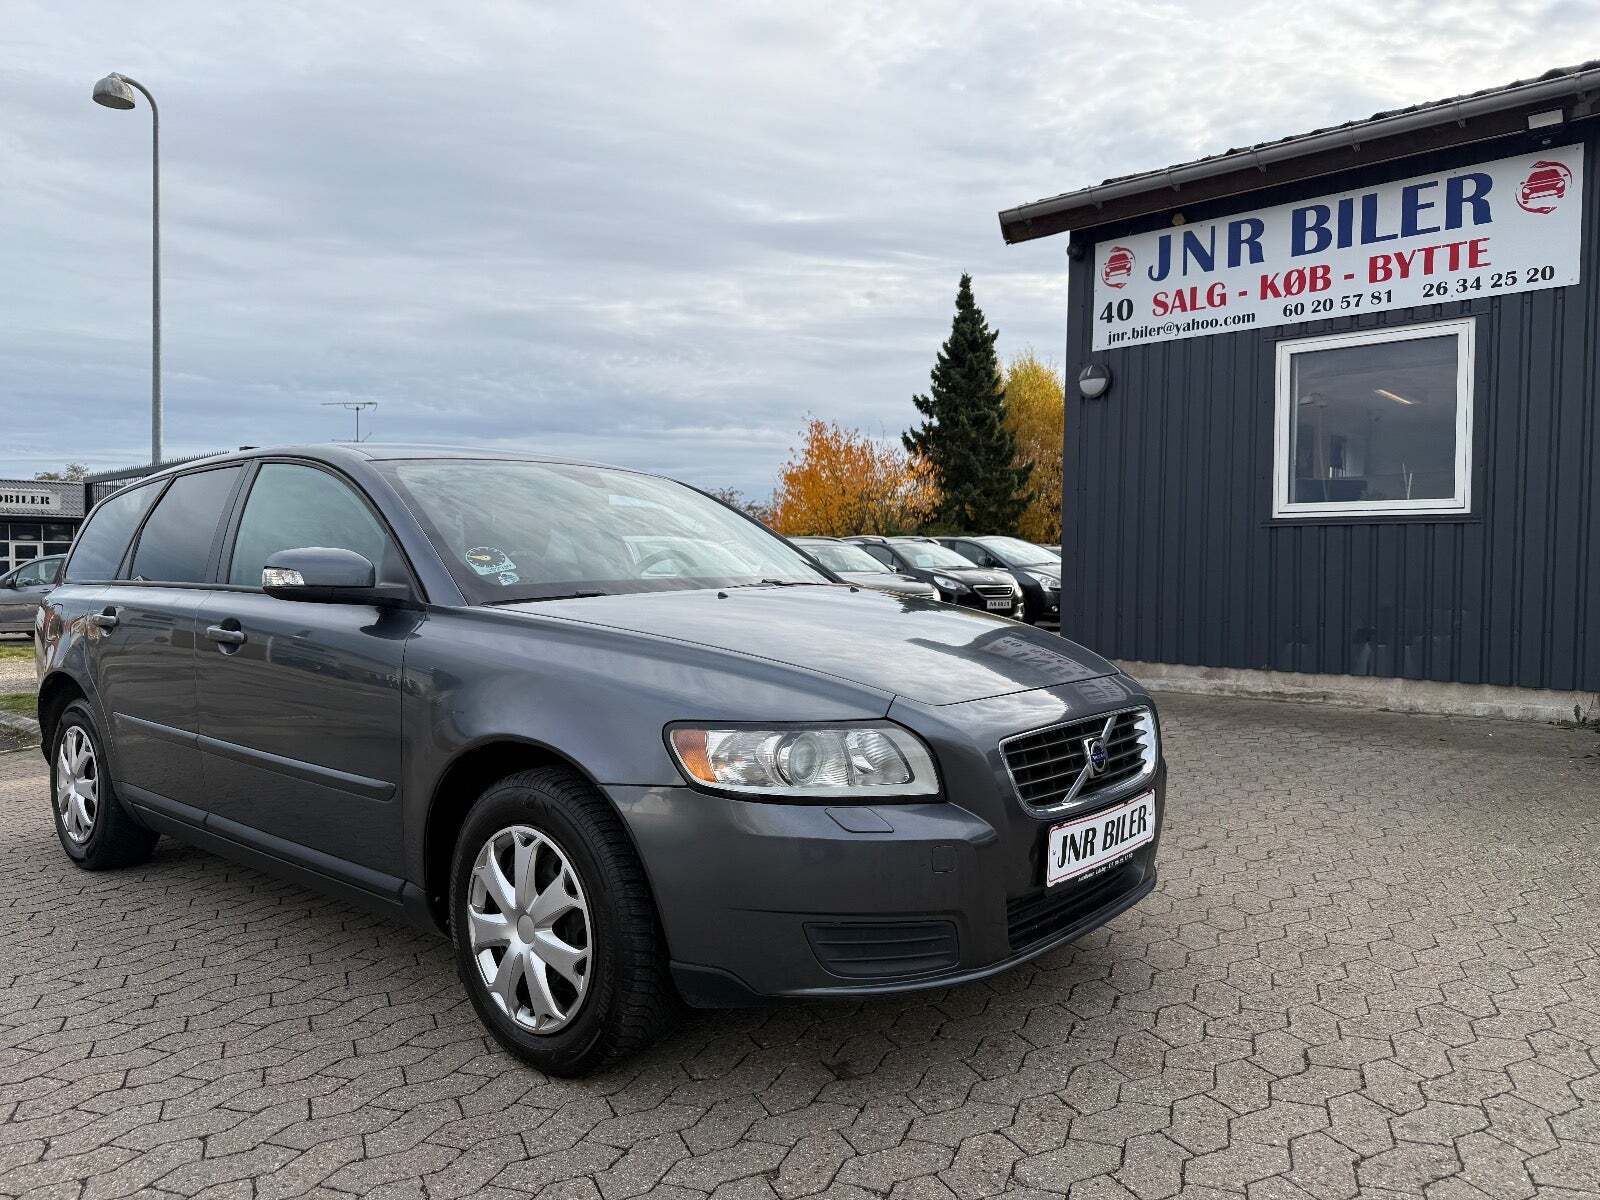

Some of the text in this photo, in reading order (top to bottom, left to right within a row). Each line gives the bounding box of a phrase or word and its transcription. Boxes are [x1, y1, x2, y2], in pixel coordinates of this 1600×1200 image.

[1148, 172, 1493, 282] JNR BILER
[1152, 282, 1227, 317] SALG
[1260, 264, 1332, 300] KØB
[1368, 237, 1492, 284] BYTTE
[1422, 265, 1555, 299] 26 34 25 20
[1100, 298, 1134, 324] 40
[1282, 289, 1393, 318] 60 20 57 81
[1107, 311, 1256, 345] jnr.biler@yahoo.com
[1057, 827, 1097, 869] JNR
[1102, 804, 1147, 852] BILER
